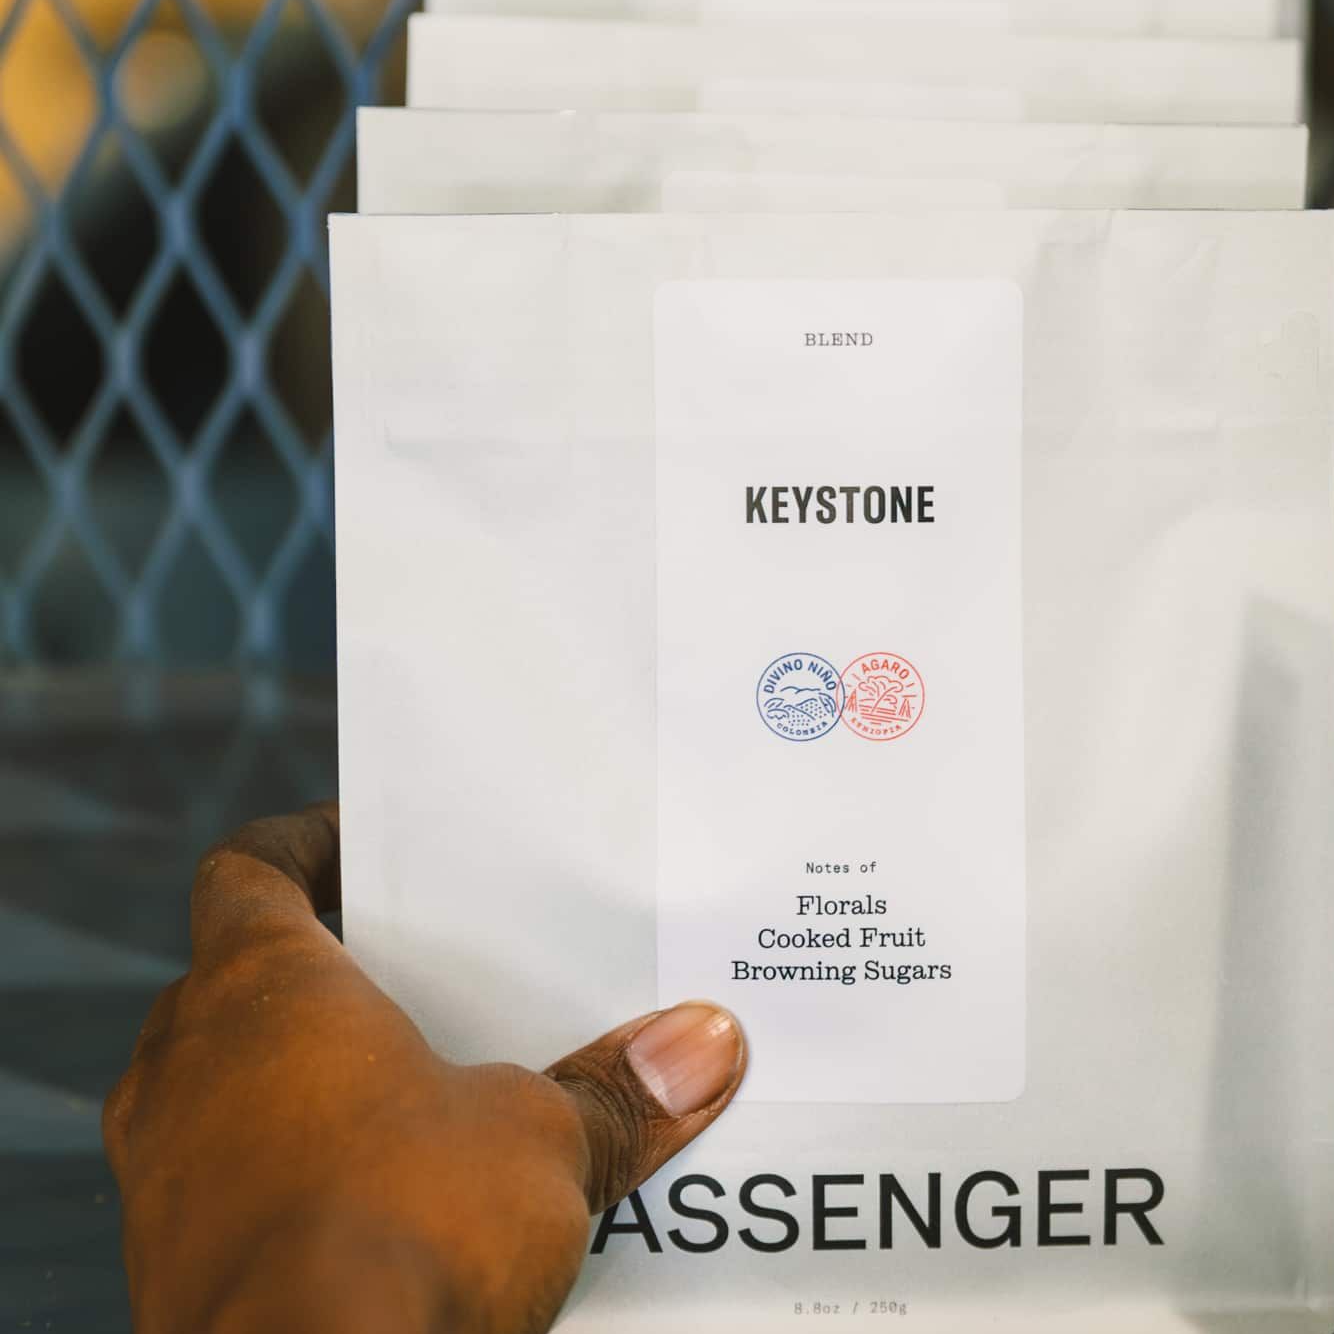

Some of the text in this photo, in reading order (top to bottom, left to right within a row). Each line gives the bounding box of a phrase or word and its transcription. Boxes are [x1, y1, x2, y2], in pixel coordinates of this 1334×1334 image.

[803, 332, 874, 347] BLEND
[745, 485, 936, 525] KEYSTONE
[763, 658, 837, 694] DIVINO NIÑO
[860, 659, 910, 680] AGARO
[776, 720, 828, 736] COLOMBIA
[805, 861, 877, 875] Notes of
[796, 894, 888, 916] Florals
[757, 926, 927, 949] Cooked Fruit
[730, 959, 953, 986] Browning Sugars
[589, 1168, 1165, 1255] ASSENGER
[793, 1300, 841, 1316] 8.8oz
[869, 1299, 908, 1318] 250g
